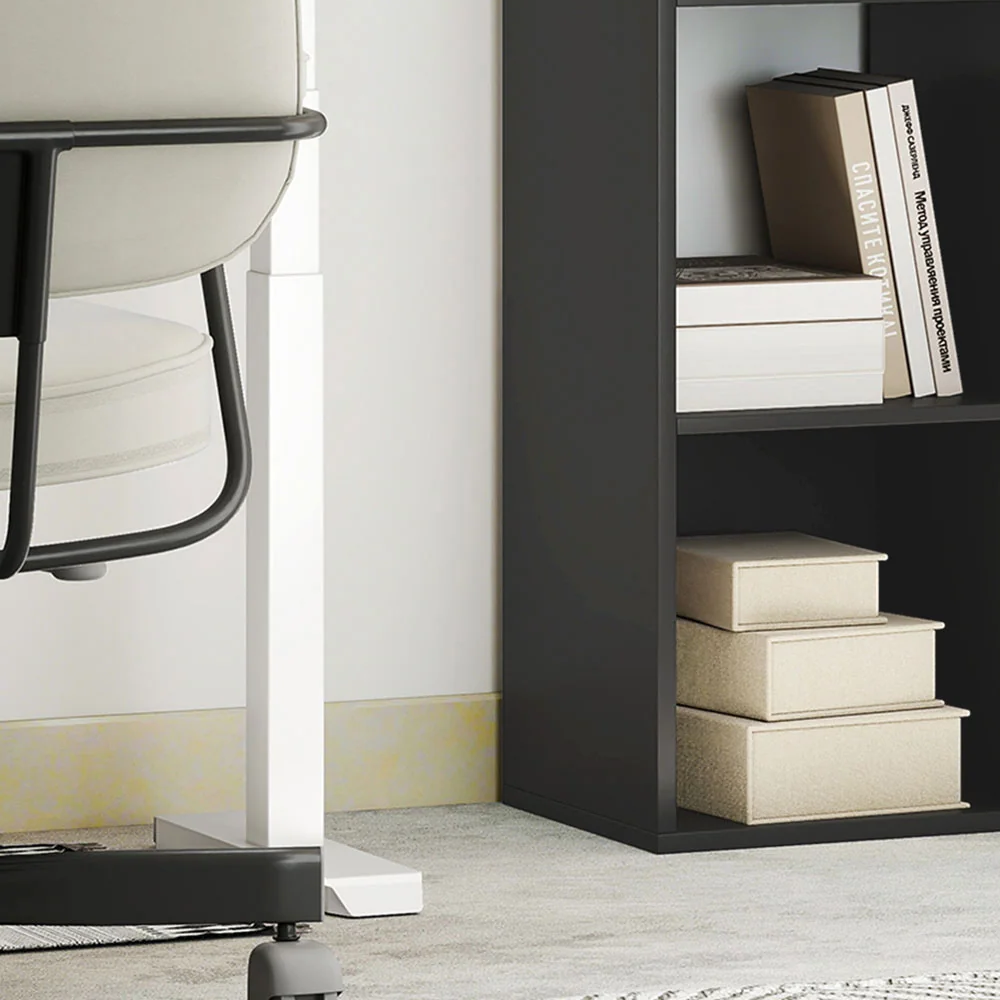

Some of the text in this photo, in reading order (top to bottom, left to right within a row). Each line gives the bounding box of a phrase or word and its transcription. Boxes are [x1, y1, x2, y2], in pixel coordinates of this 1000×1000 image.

[852, 162, 883, 250] СПАСИТЕ
[914, 190, 929, 231] Метод
[932, 305, 952, 373] проектами
